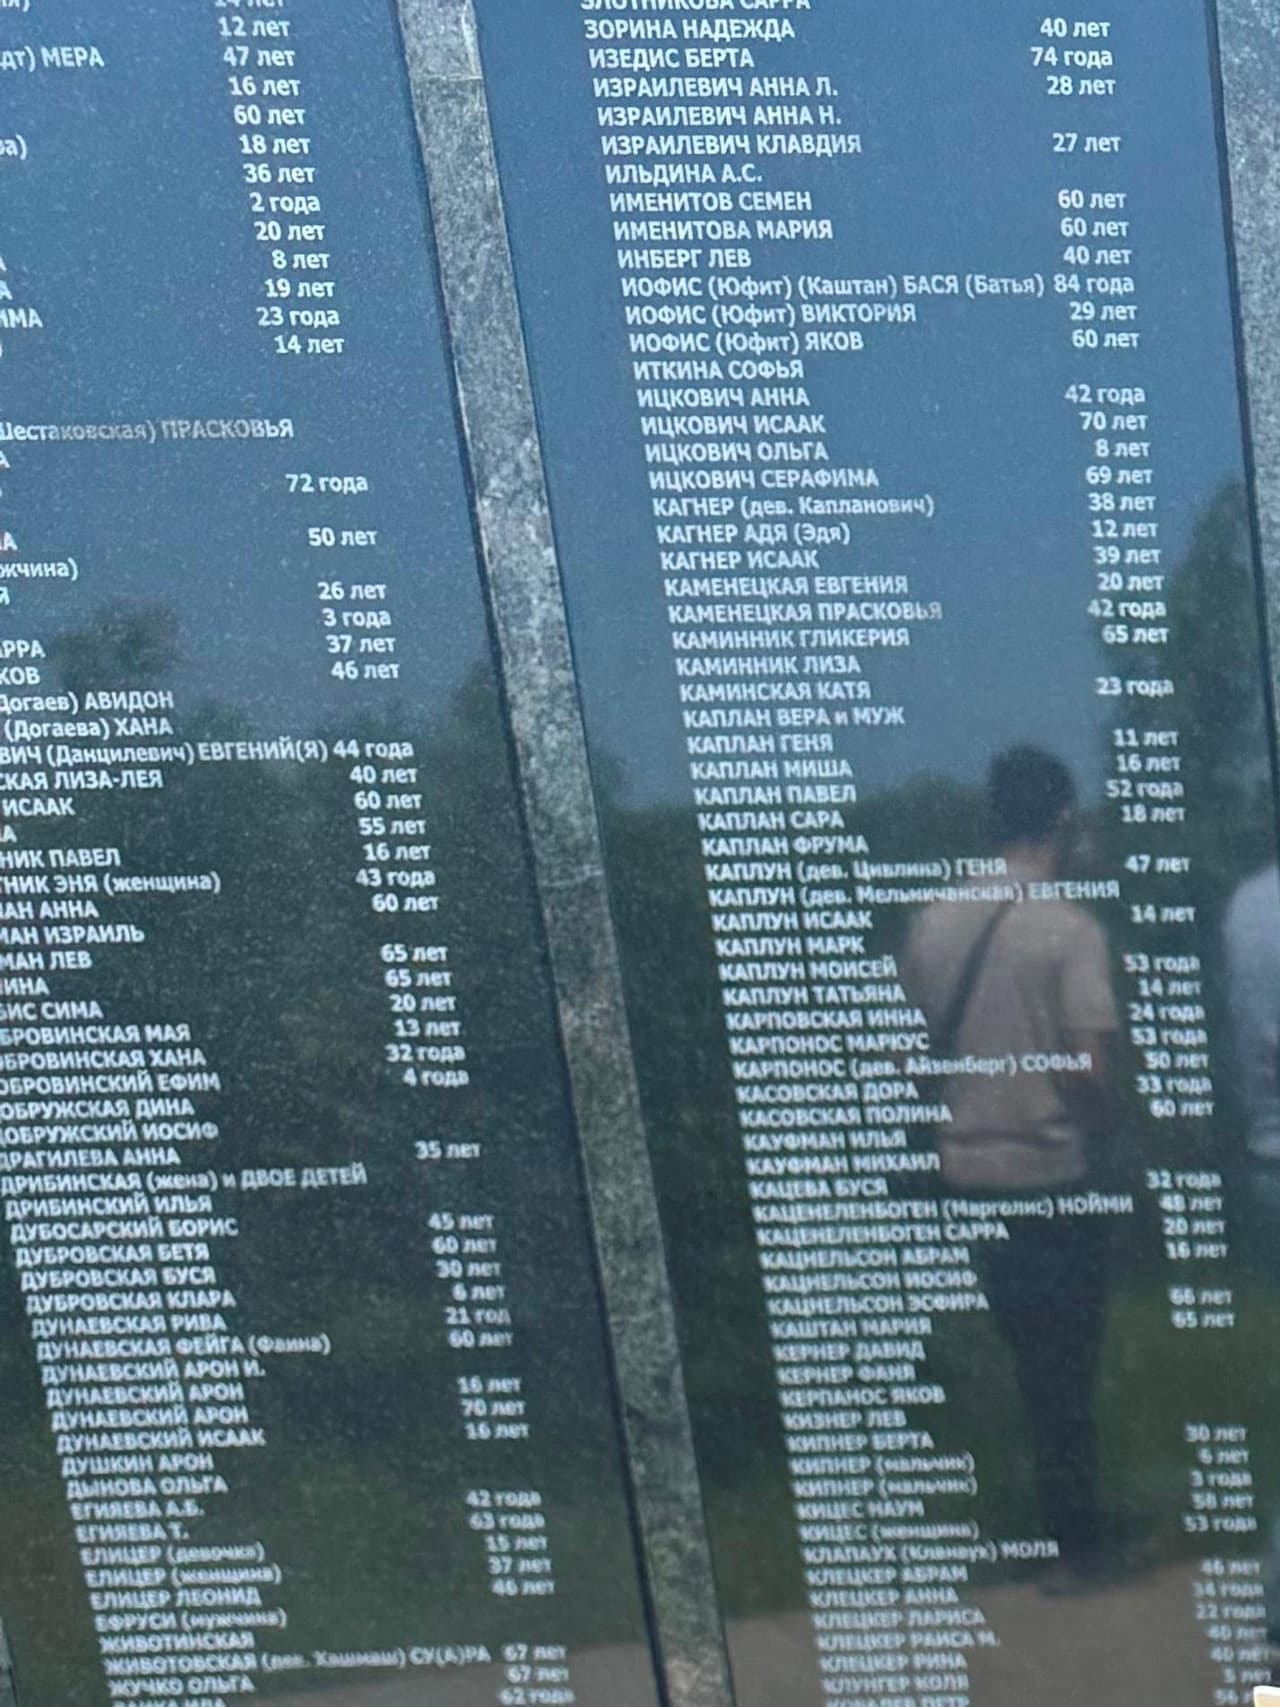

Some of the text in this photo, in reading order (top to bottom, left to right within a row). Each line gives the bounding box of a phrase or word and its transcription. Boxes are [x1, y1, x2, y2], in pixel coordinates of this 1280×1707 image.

[584, 18, 1111, 43] ЗОРИНА НАДЕЖДА 40 лет
[41, 46, 296, 68] МЕРА 47 лет
[589, 47, 1113, 72] ИЗЕДИС БЕРТА 74 года
[229, 76, 301, 96] 16 лет
[593, 76, 1116, 98] ИЗРАИЛЕВИЧ АННА Л. 28 лет
[602, 133, 1121, 158] ИЗРАИЛЕВИЧ КЛАВДИЯ 27 лет
[243, 163, 316, 183] 36 лет
[605, 164, 763, 188] ИЛЬДИНА А.С.
[250, 192, 321, 215] 2 года
[610, 189, 1127, 212] ИМЕНИТОВ СЕМЕН 60 лет
[618, 246, 1132, 269] ИНБЕРГ ЛЕВ 40 лет
[621, 274, 1135, 301] ИОФИС (Юфит) (Каштан) БАСЯ (Батья) 84 года
[653, 493, 1156, 520] КАГНЕР (дев. Капланович) 38 лет
[664, 572, 1165, 599] КАМЕНЕЦКАЯ ЕВГЕНИЯ 20 лет
[680, 677, 1174, 703] КАМИНСКАЯ КАТЯ 23 года
[4, 717, 174, 743] (Догаева) ХАНА
[683, 707, 906, 729] КАПЛАН ВЕРА и МУЖ
[47, 736, 414, 768] (Данцилевич) ЕВГЕНИЙ(Я) 44 года
[54, 765, 417, 790] ЛИЗА-ЛЕЯ 40 лет
[691, 754, 1181, 780] КАПЛАН МИША 16 лет
[2, 791, 422, 817] ИСААК 60 лет
[53, 868, 435, 897] ЭНЯ (женщина) 43 года
[44, 925, 145, 945] ИЗРАИЛЬ
[145, 1019, 461, 1043] МАЯ 13 лет
[158, 1068, 469, 1091] ЕФИМ 4 года
[751, 1178, 889, 1200] КАЦЕВА БУСЯ
[5, 1191, 213, 1221] ДРИБИНСКИЙ ИЛЬЯ
[11, 1213, 494, 1245] ДУБОСАРСКИЙ БОРИС 45 лет
[761, 1248, 970, 1270] КАЦНЕЛЬСОН АБРАМ
[62, 1453, 214, 1478] ДУШКИН АРОН
